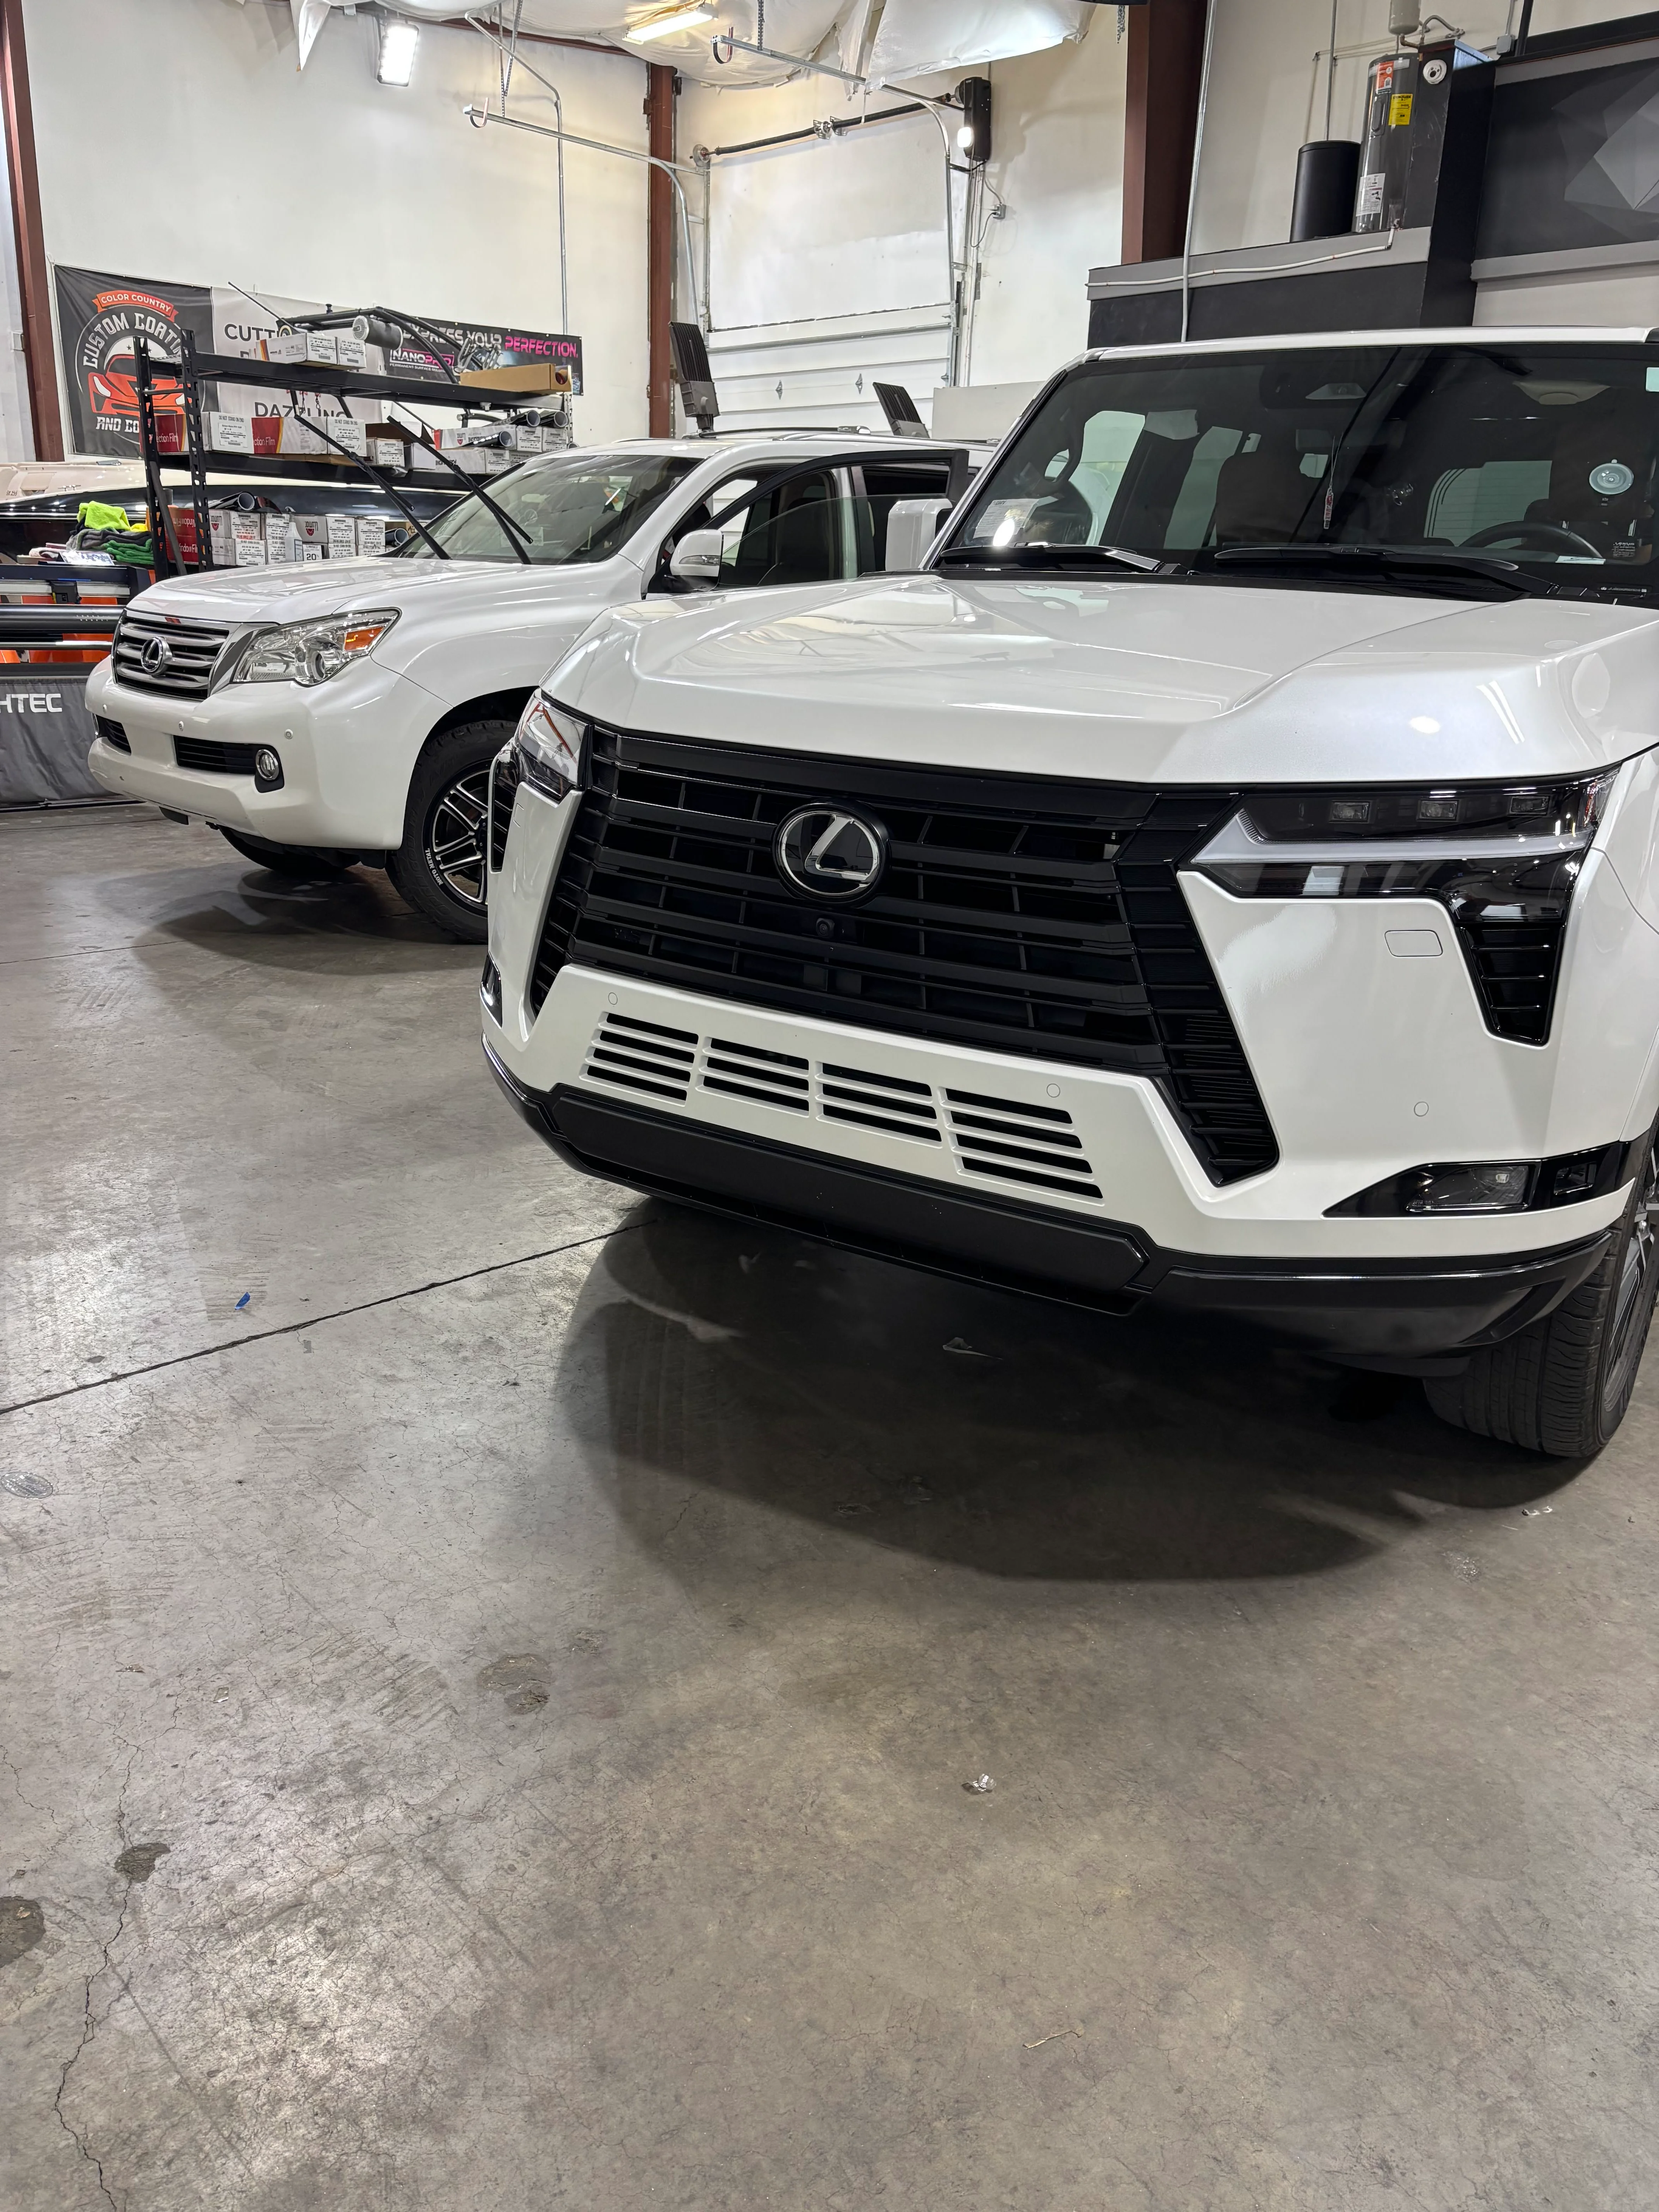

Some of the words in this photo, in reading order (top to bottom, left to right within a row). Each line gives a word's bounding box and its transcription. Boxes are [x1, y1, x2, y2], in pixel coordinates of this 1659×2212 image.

[101, 294, 129, 303] COLOR
[131, 294, 171, 312] COUNTRY
[83, 313, 129, 369] CUSTOM
[96, 416, 121, 431] AND
[266, 436, 275, 446] Film
[425, 848, 435, 869] METAL
[432, 869, 443, 885] MOTO
